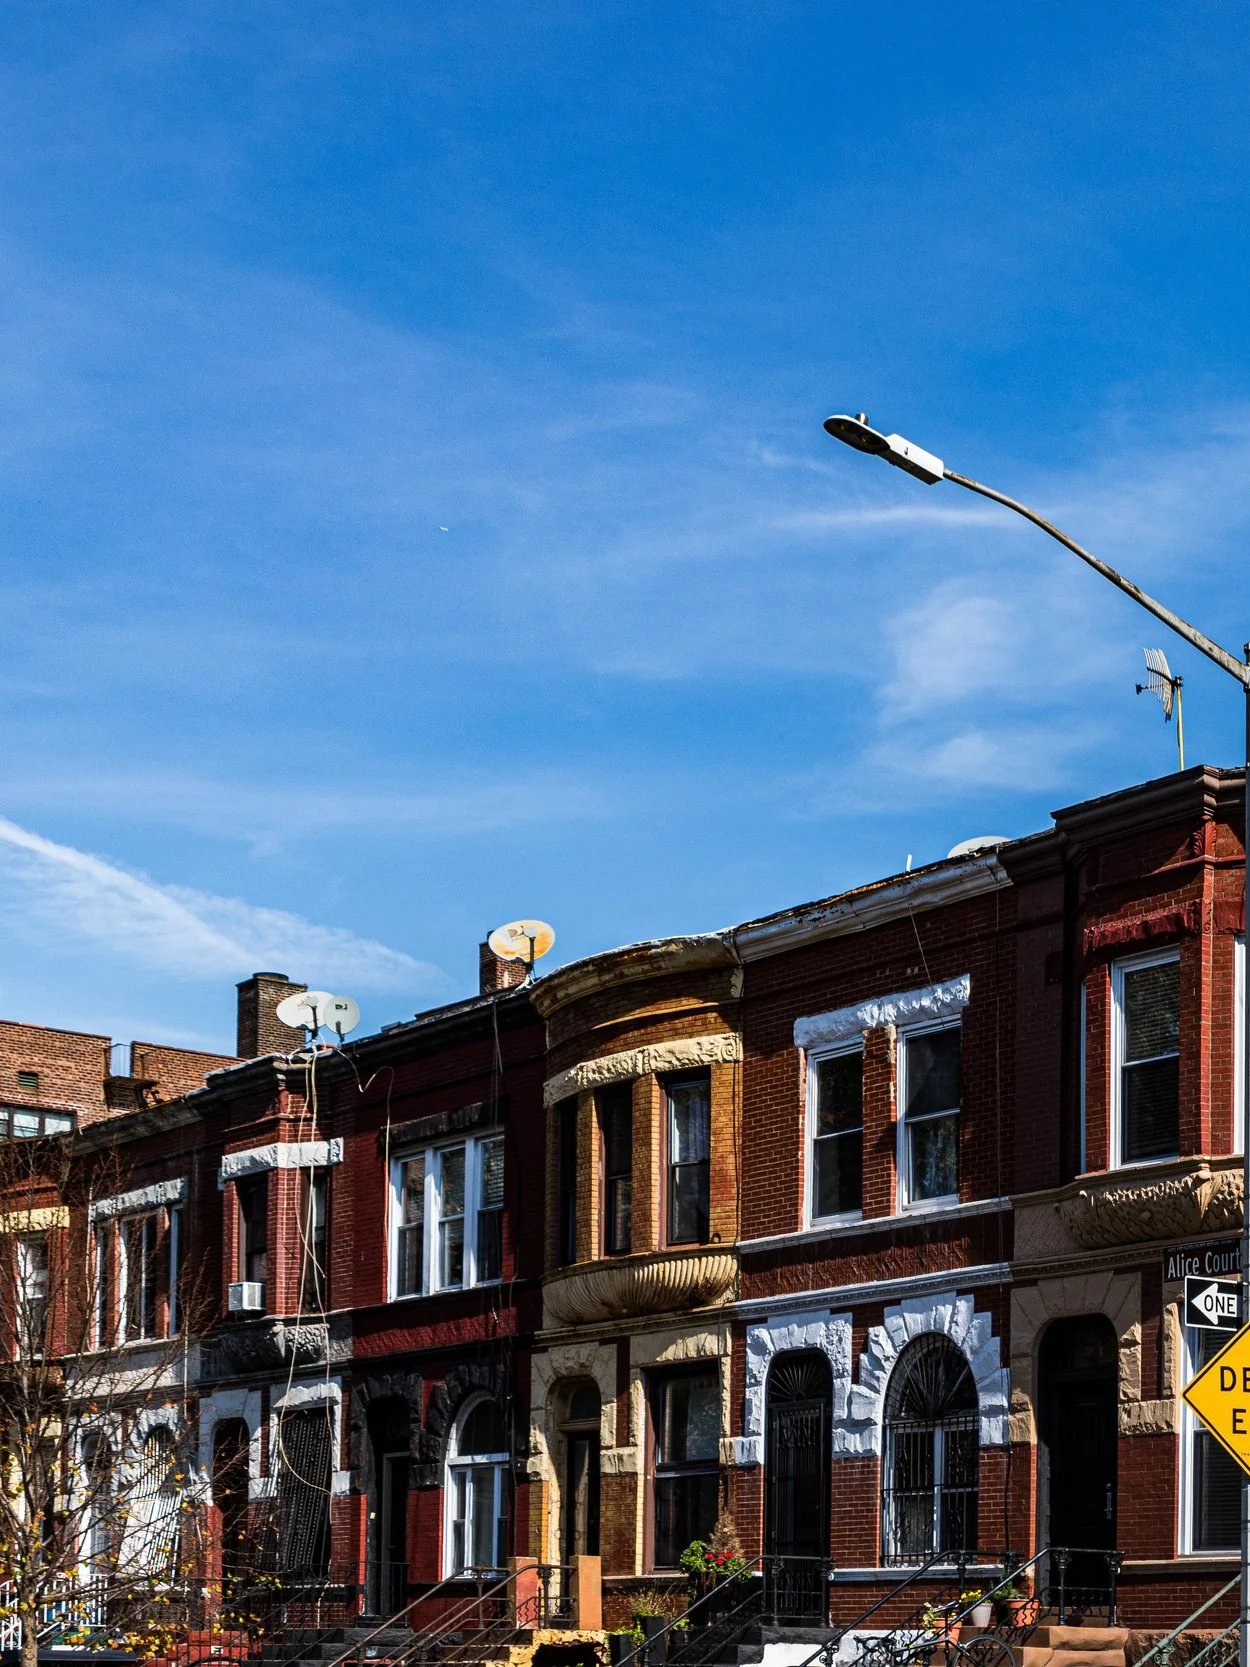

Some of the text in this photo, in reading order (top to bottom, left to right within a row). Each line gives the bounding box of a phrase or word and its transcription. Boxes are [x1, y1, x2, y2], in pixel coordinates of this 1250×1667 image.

[1167, 1247, 1241, 1279] Alice Court
[1204, 1294, 1236, 1315] ONE
